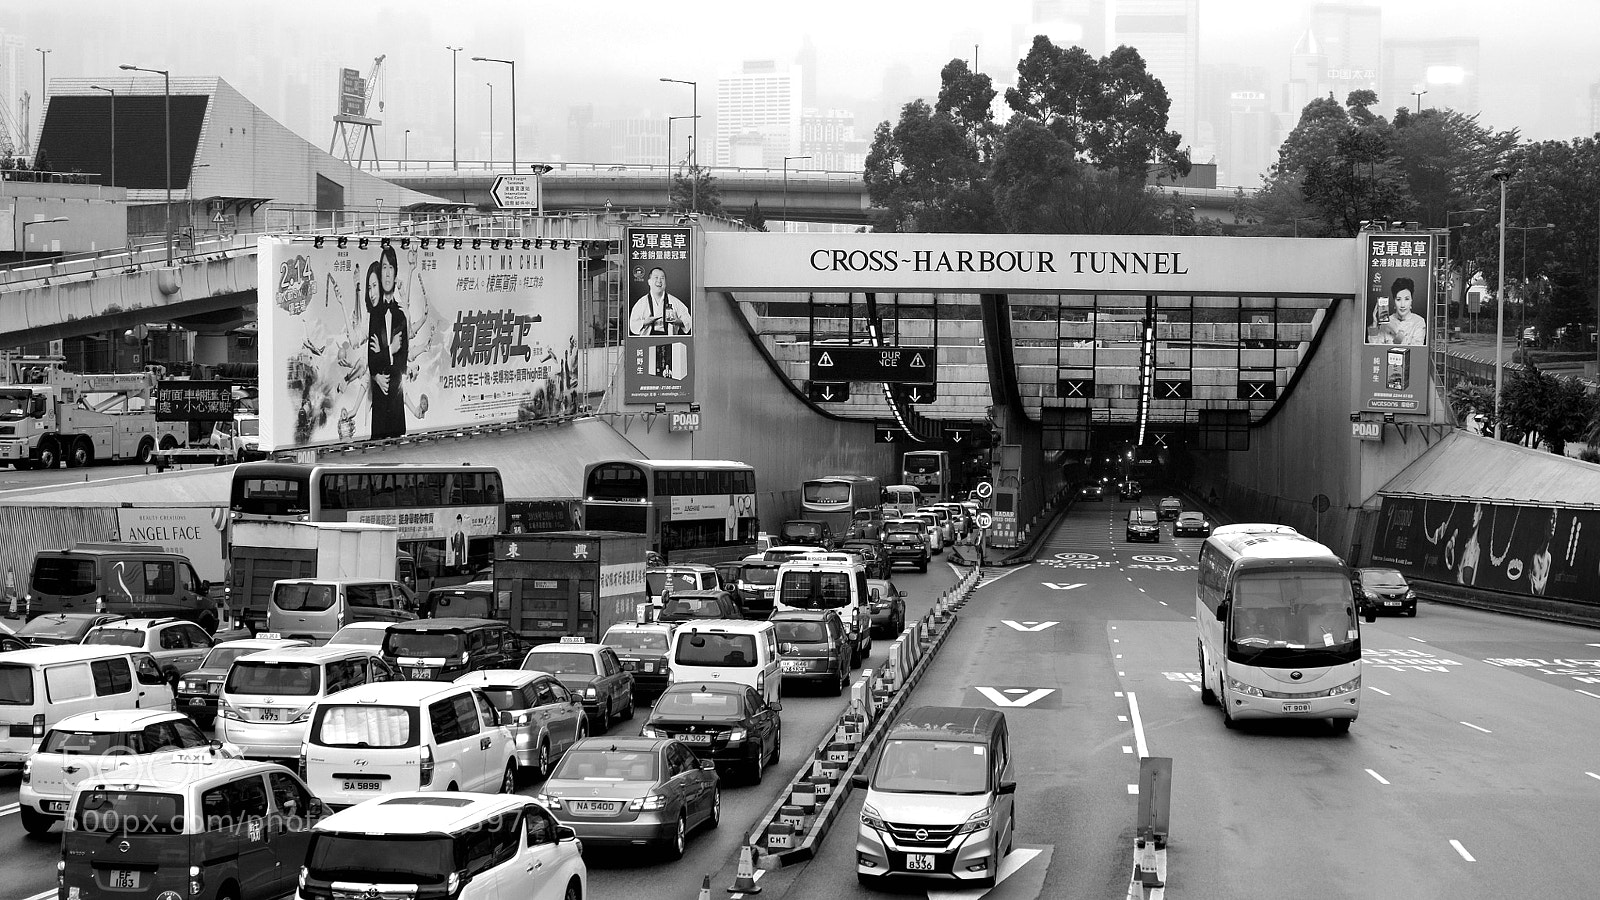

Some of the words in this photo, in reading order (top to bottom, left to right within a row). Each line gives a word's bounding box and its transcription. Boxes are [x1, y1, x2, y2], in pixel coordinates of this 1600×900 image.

[1328, 69, 1375, 80] 中国太平
[632, 234, 686, 248] 冠軍蟲草
[1372, 241, 1426, 256] 冠軍蟲草
[457, 254, 492, 270] AGENT
[500, 254, 512, 270] MR
[520, 254, 544, 269] CHAN
[1070, 251, 1189, 275] TUNNEL
[280, 255, 312, 289] 2.14
[673, 414, 699, 426] POAD
[1352, 424, 1379, 436] POAD
[297, 451, 315, 463] POAD
[980, 517, 989, 525] 70
[129, 526, 170, 541] ANGEL
[172, 526, 202, 540] FACE
[506, 542, 520, 558] 東
[572, 543, 588, 559] 興
[344, 782, 355, 790] SA
[357, 782, 380, 790] 5899
[53, 803, 62, 811] TG
[591, 803, 614, 811] 5400
[770, 836, 787, 844] CHT
[909, 861, 932, 869] 8336
[119, 870, 131, 879] EF
[116, 878, 133, 887] 1183
